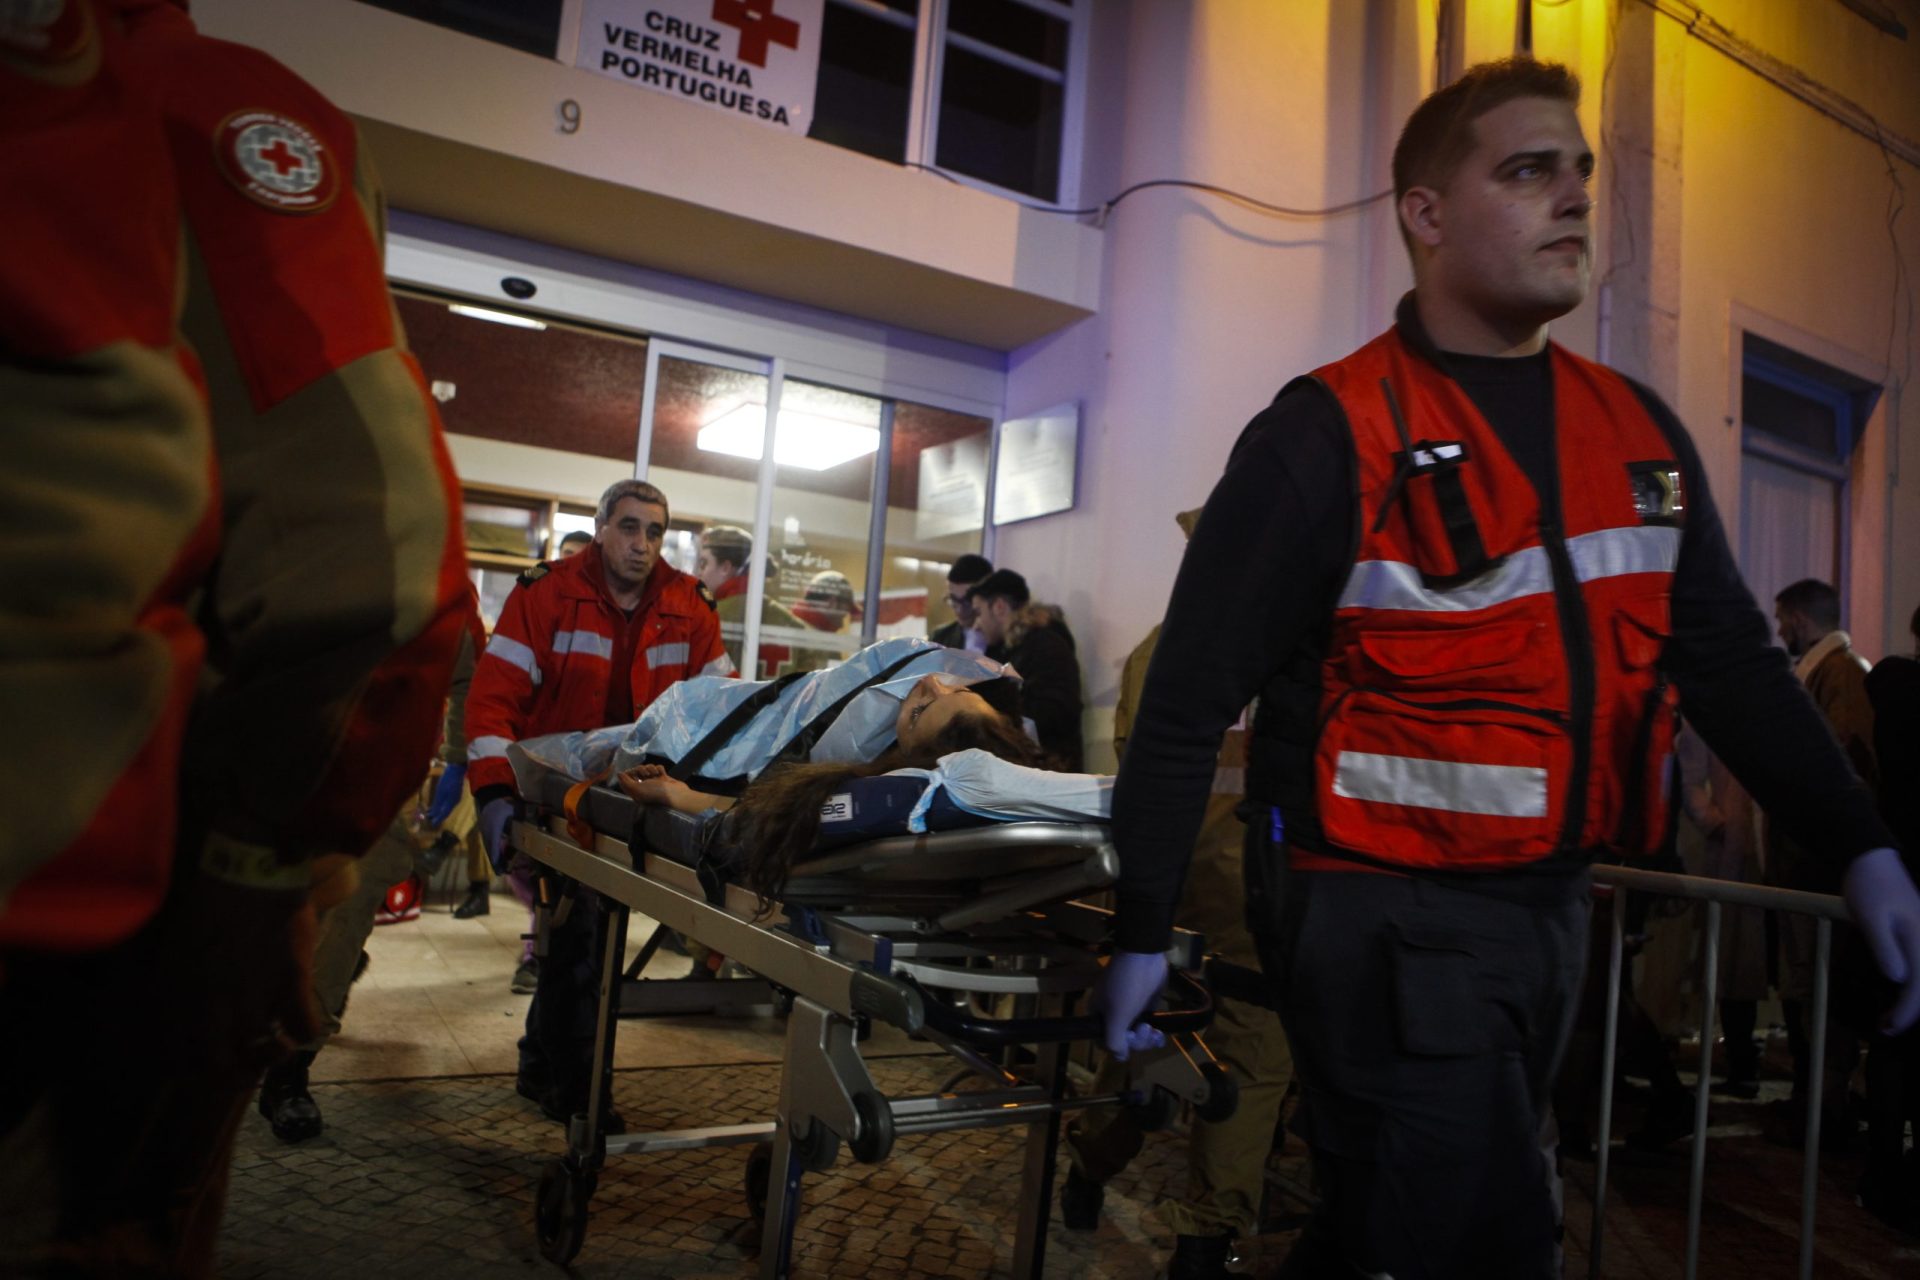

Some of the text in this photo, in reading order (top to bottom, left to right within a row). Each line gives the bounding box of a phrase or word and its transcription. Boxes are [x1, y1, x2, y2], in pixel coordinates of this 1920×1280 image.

[604, 22, 753, 88] VERMELHA
[645, 10, 721, 51] CRUZ
[601, 51, 790, 126] PORTUGUESA
[560, 99, 581, 135] 9
